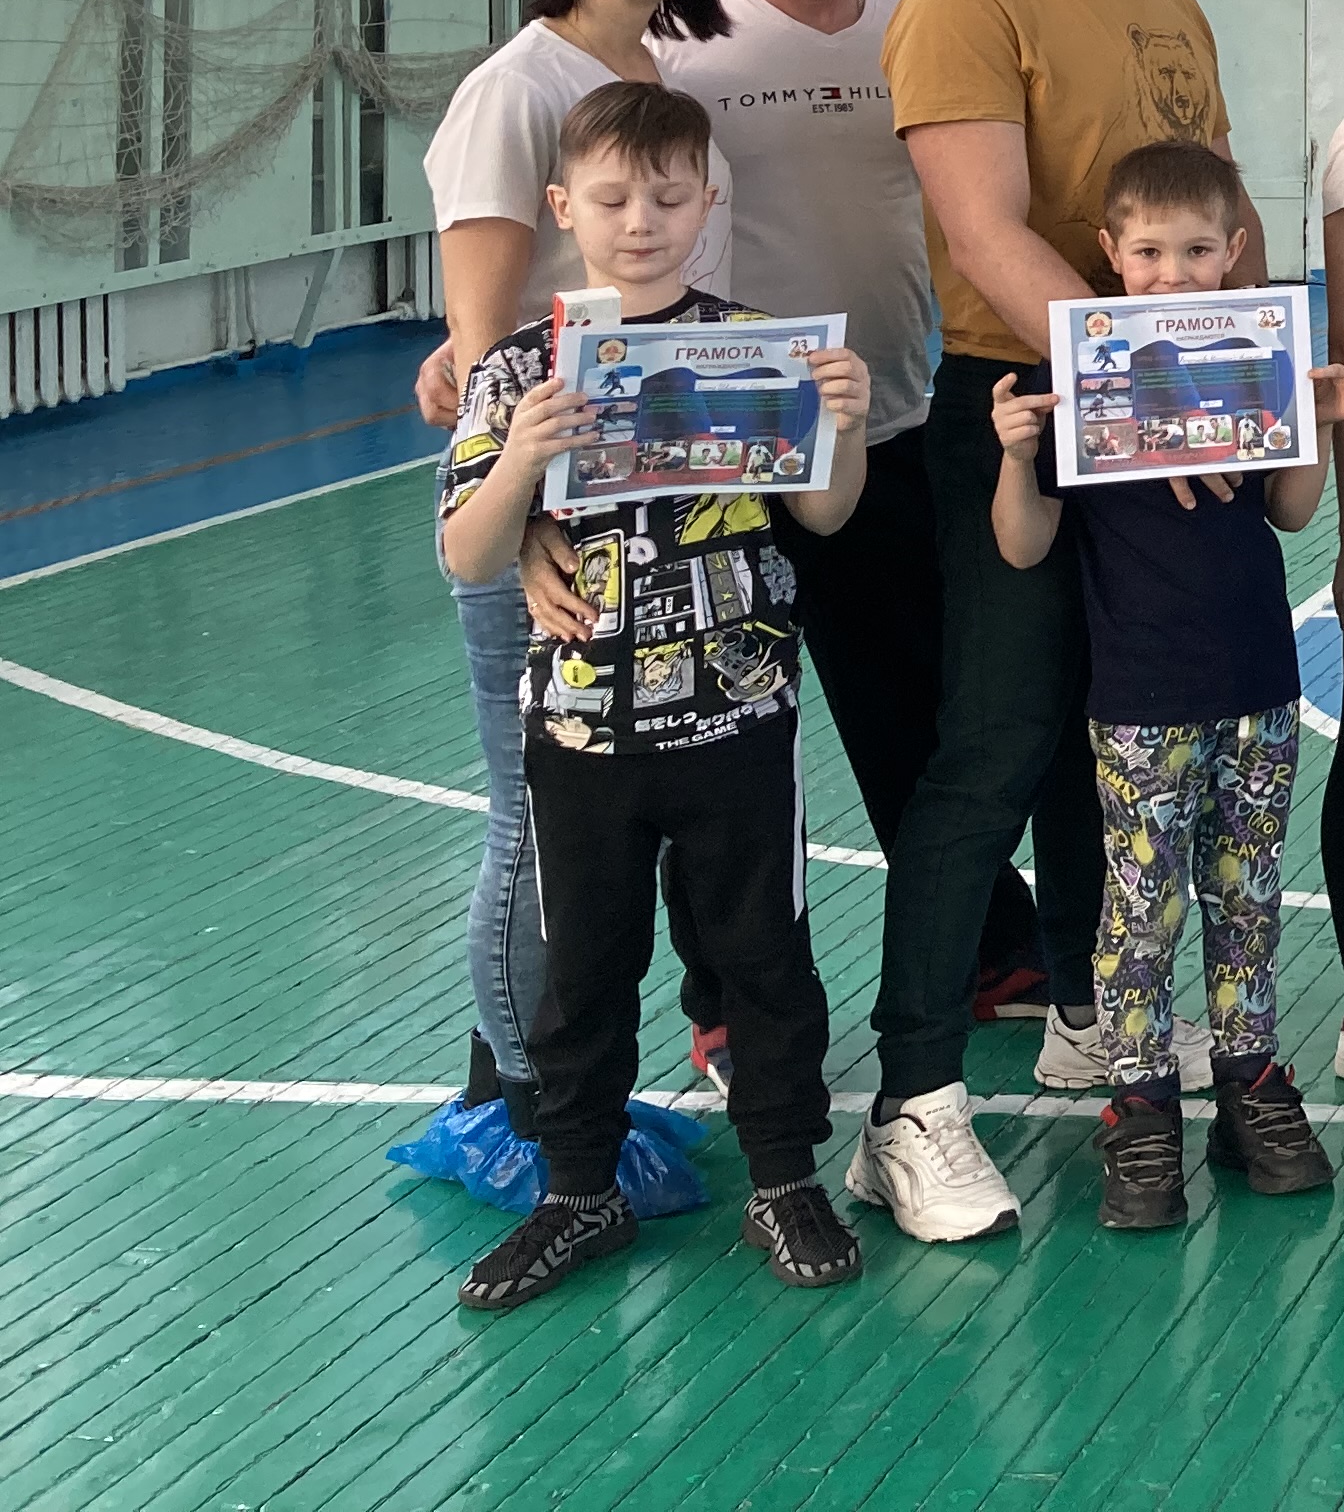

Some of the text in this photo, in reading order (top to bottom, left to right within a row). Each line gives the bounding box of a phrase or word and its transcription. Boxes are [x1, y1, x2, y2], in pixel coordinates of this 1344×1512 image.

[718, 87, 892, 111] TOMMY HIL
[1155, 315, 1236, 334] ГРАМОТА
[1258, 309, 1276, 324] 23
[674, 345, 764, 361] ГРАМОТА
[790, 338, 809, 354] 23
[655, 736, 690, 750] THE
[691, 721, 738, 742] GAME
[1214, 835, 1262, 861] PLAY
[1212, 963, 1258, 983] PLAY
